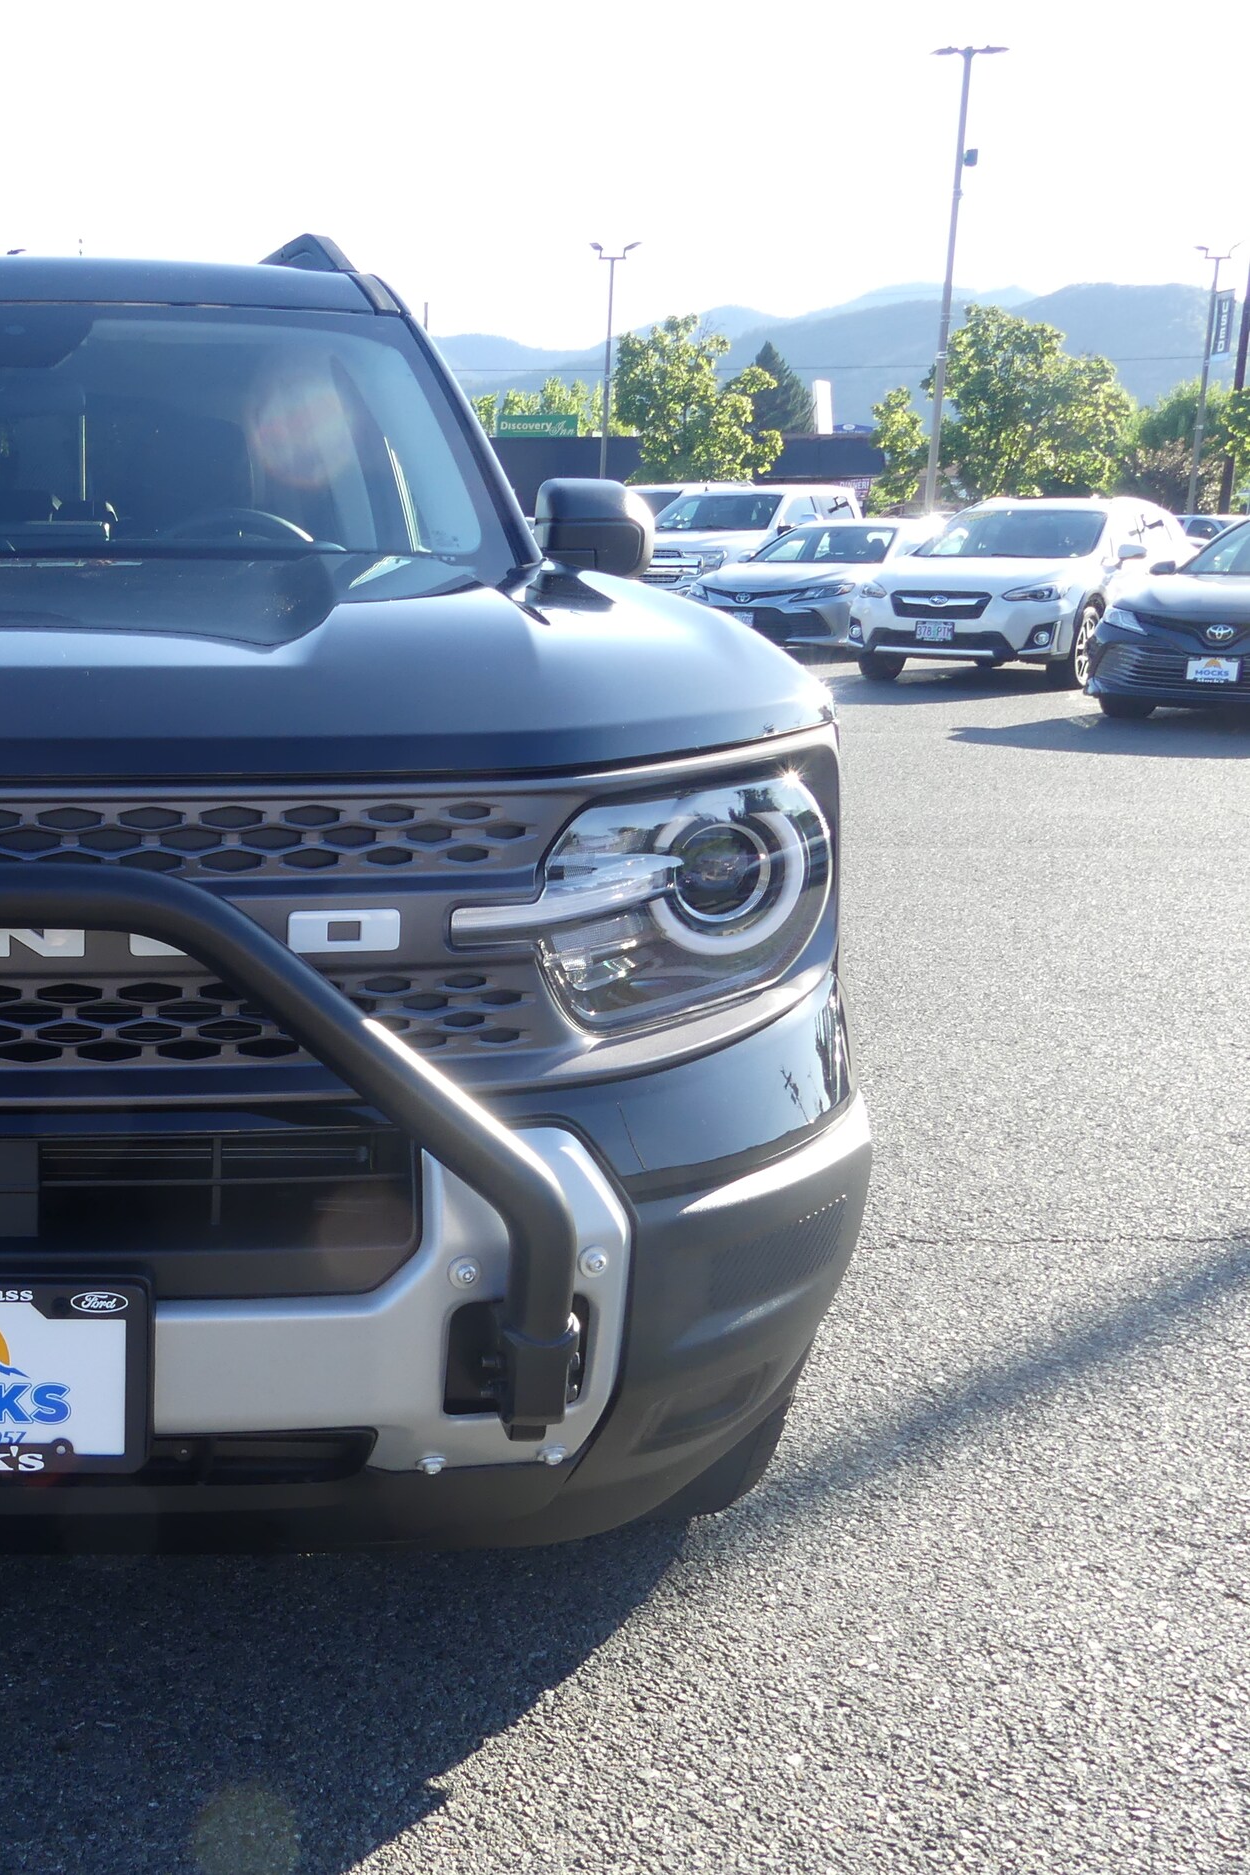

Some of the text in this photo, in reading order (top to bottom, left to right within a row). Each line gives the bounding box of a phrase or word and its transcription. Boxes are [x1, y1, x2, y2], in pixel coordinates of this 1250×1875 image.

[1217, 301, 1229, 352] USED
[500, 420, 575, 436] Discovery Inn
[1195, 669, 1229, 677] MOCKS
[81, 1294, 117, 1309] Ford
